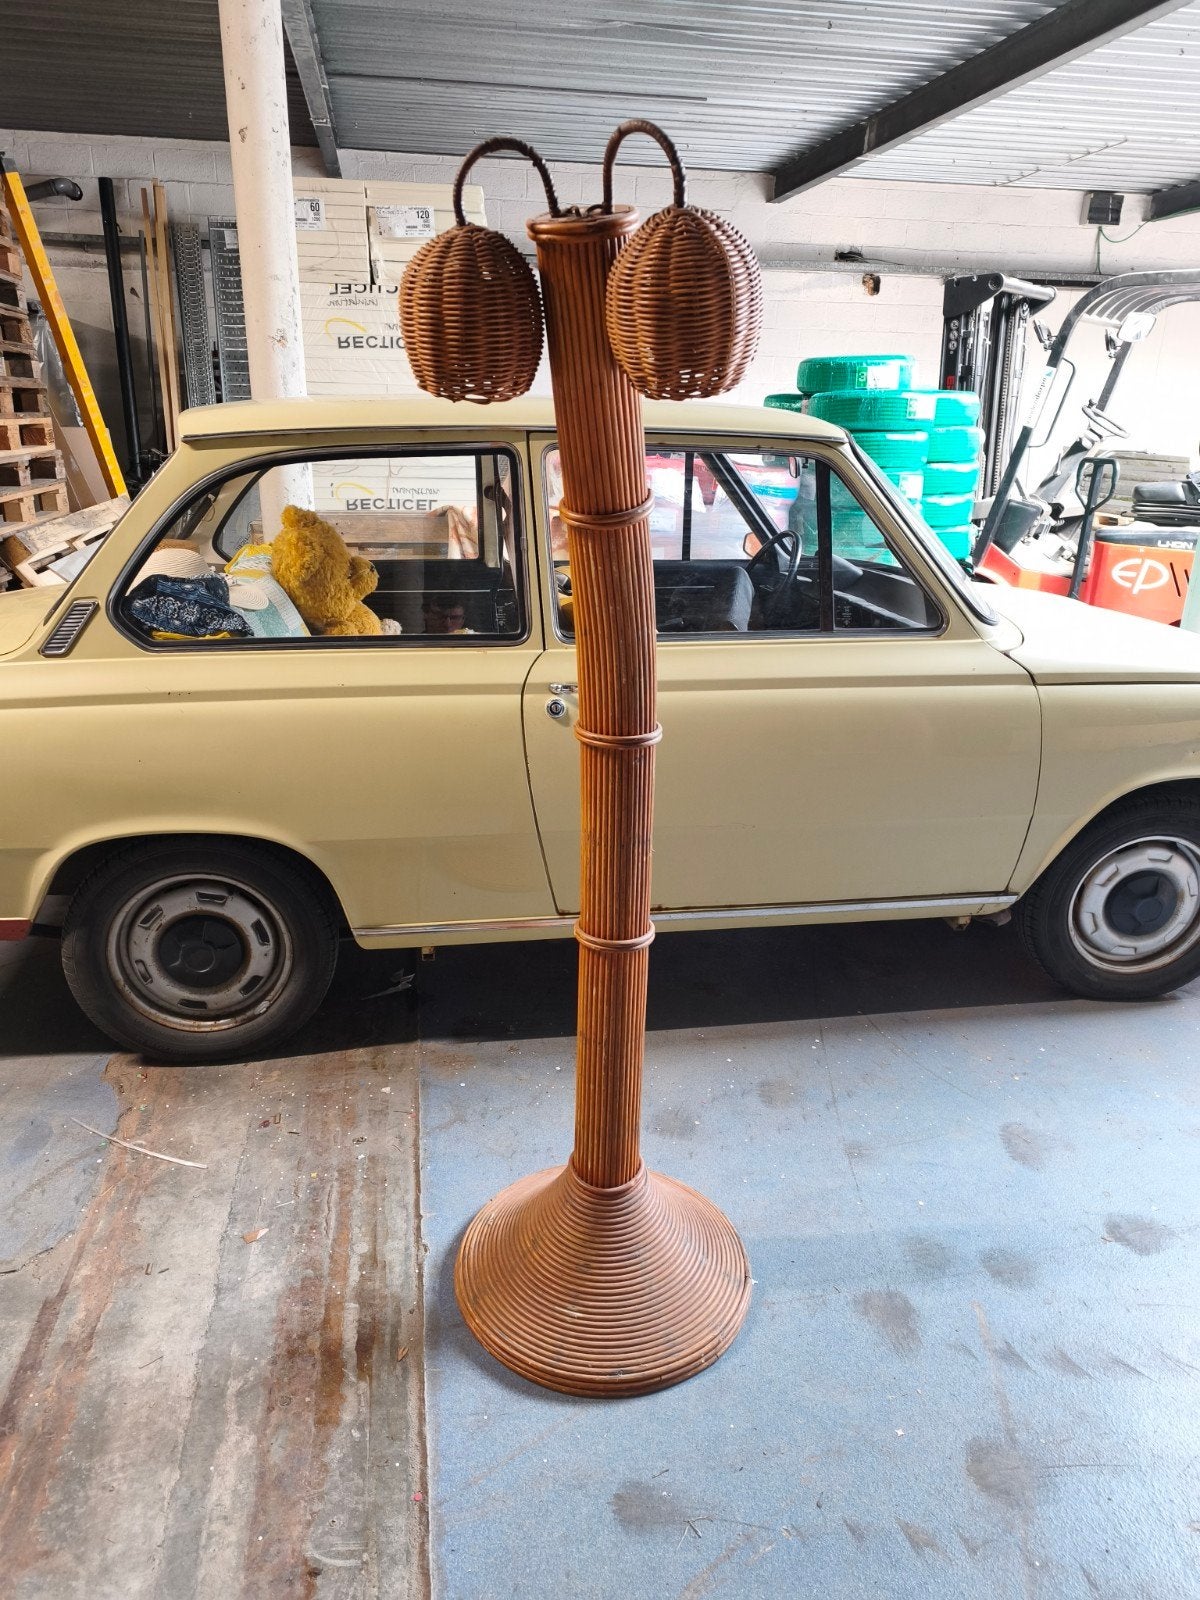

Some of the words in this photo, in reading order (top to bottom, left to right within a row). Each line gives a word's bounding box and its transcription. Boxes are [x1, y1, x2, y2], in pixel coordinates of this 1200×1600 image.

[310, 202, 320, 212] 60
[416, 210, 430, 219] 120
[1111, 557, 1170, 595] EP
